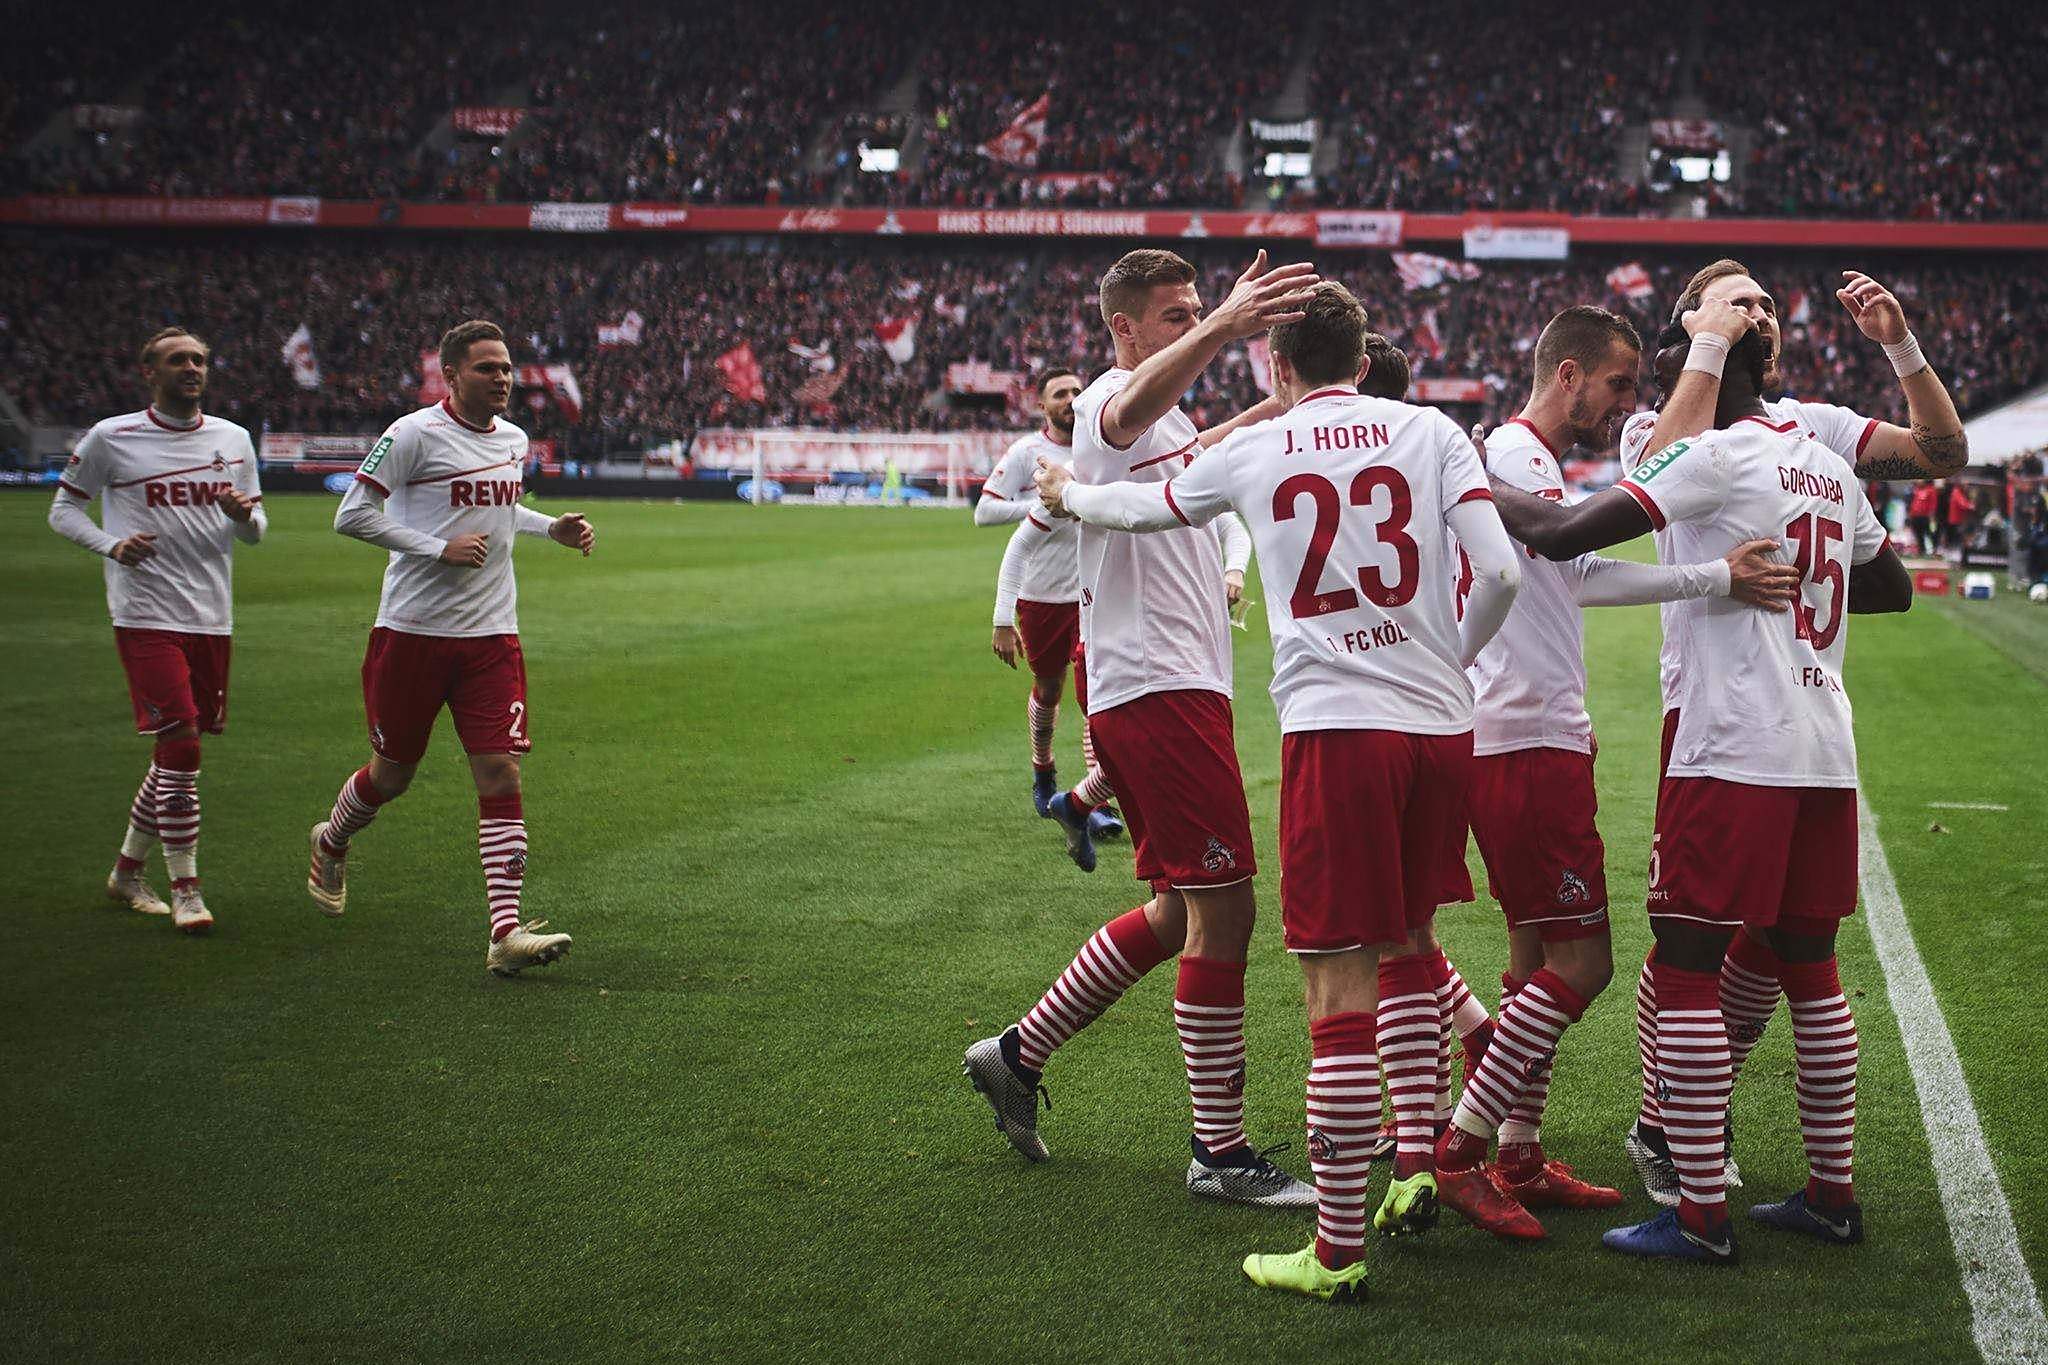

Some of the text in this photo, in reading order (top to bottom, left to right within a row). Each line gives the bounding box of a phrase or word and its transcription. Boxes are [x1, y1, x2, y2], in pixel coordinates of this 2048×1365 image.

[938, 212, 981, 234] HANS
[364, 437, 392, 472] DEVK
[1284, 424, 1390, 455] J. HORN
[1637, 442, 1687, 481] DEVK
[1777, 465, 1844, 506] CORDOBA
[1272, 465, 1420, 619] 23
[1785, 511, 1845, 651] 15
[1343, 630, 1371, 654] FC
[1371, 619, 1412, 648] KÖL
[1802, 667, 1824, 687] FC
[508, 700, 525, 739] 2
